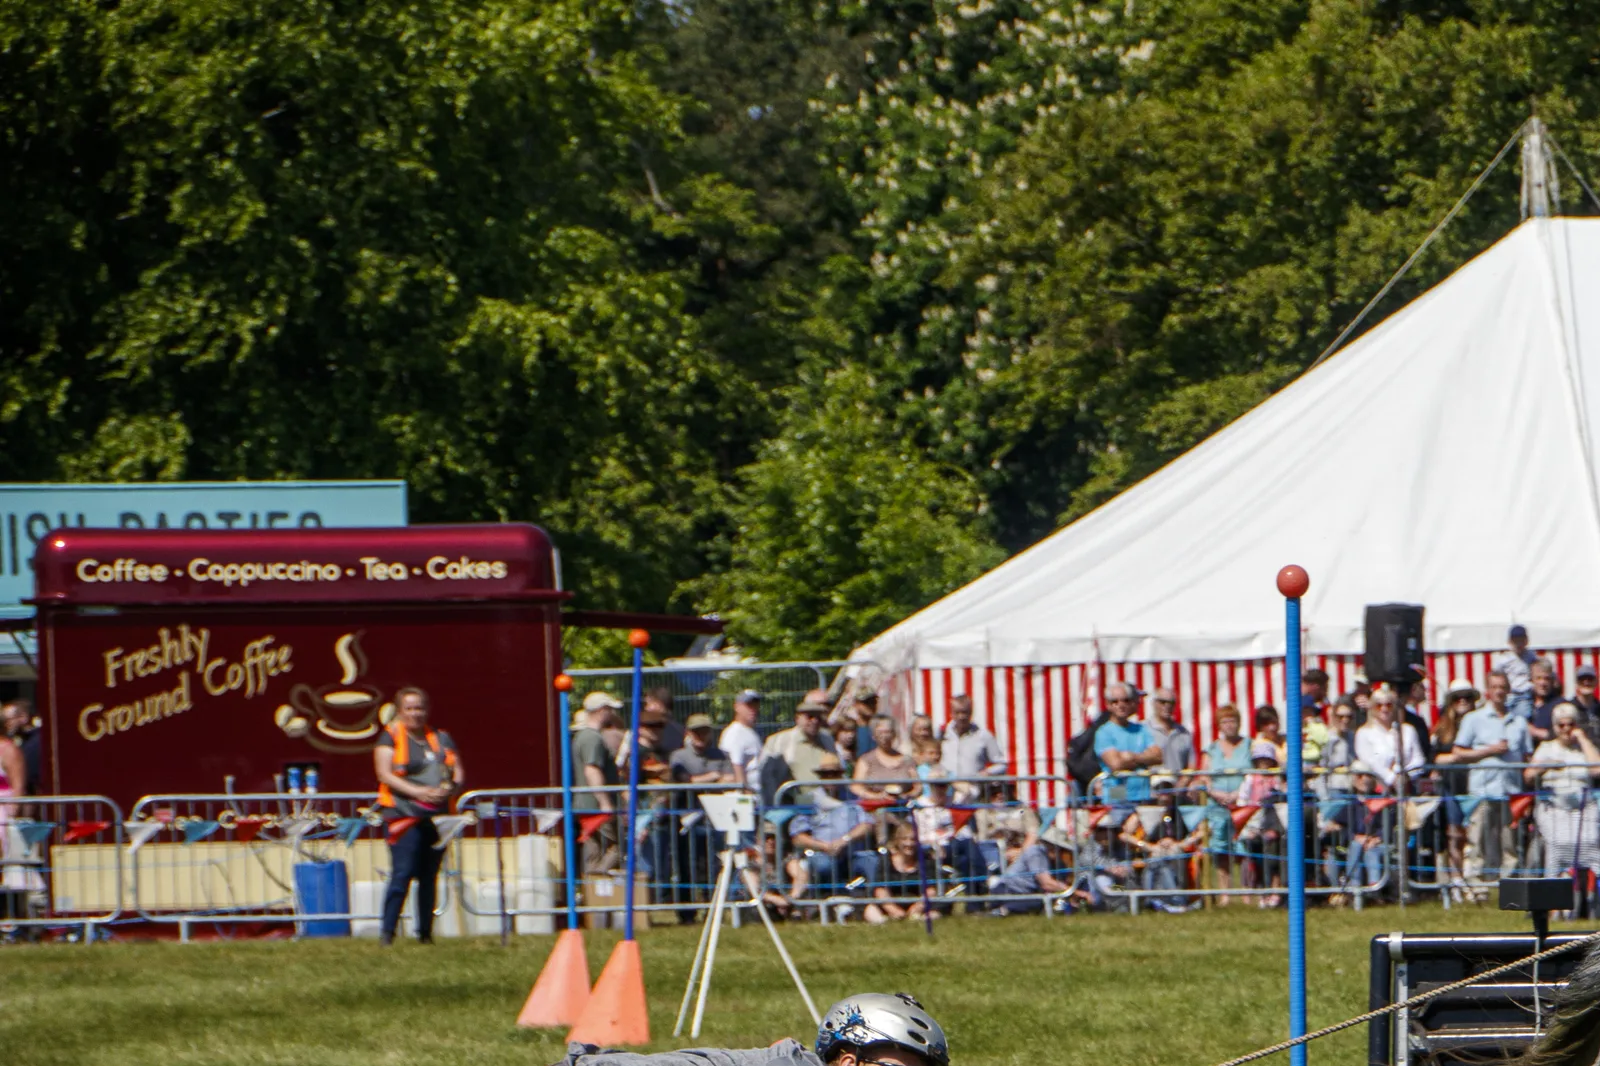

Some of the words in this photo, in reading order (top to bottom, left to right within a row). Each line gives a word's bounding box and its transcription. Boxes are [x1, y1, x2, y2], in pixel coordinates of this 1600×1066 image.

[76, 558, 169, 583] Coffee
[188, 557, 340, 587] Cappuccino
[359, 556, 408, 581] Tea
[426, 556, 507, 581] Cakes
[103, 624, 210, 688] Freshly
[78, 671, 192, 742] Ground
[202, 635, 293, 699] Coffee
